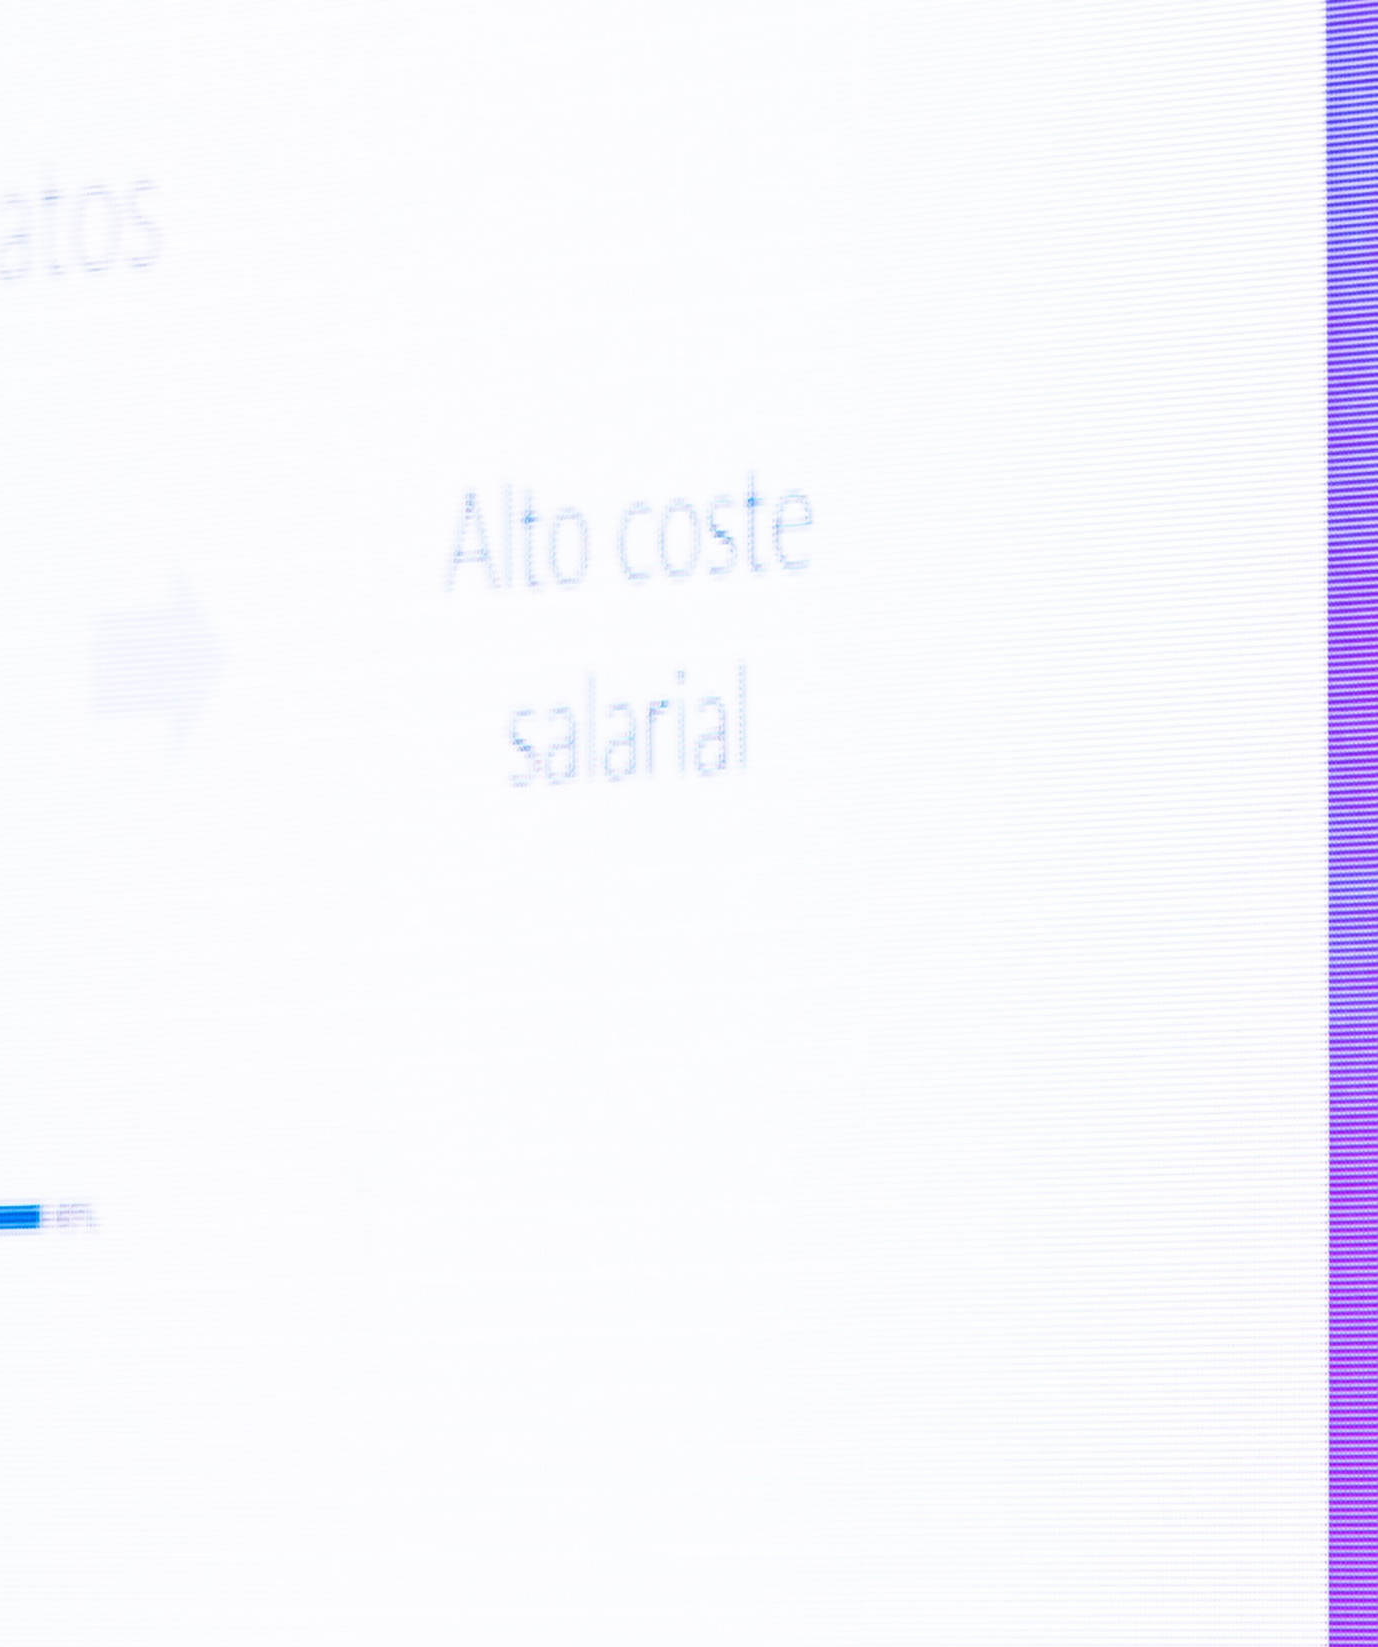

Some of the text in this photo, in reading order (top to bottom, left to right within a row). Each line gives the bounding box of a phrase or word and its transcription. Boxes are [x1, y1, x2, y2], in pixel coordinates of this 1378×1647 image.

[442, 466, 817, 593] Alto coste
[505, 660, 749, 789] salarial
